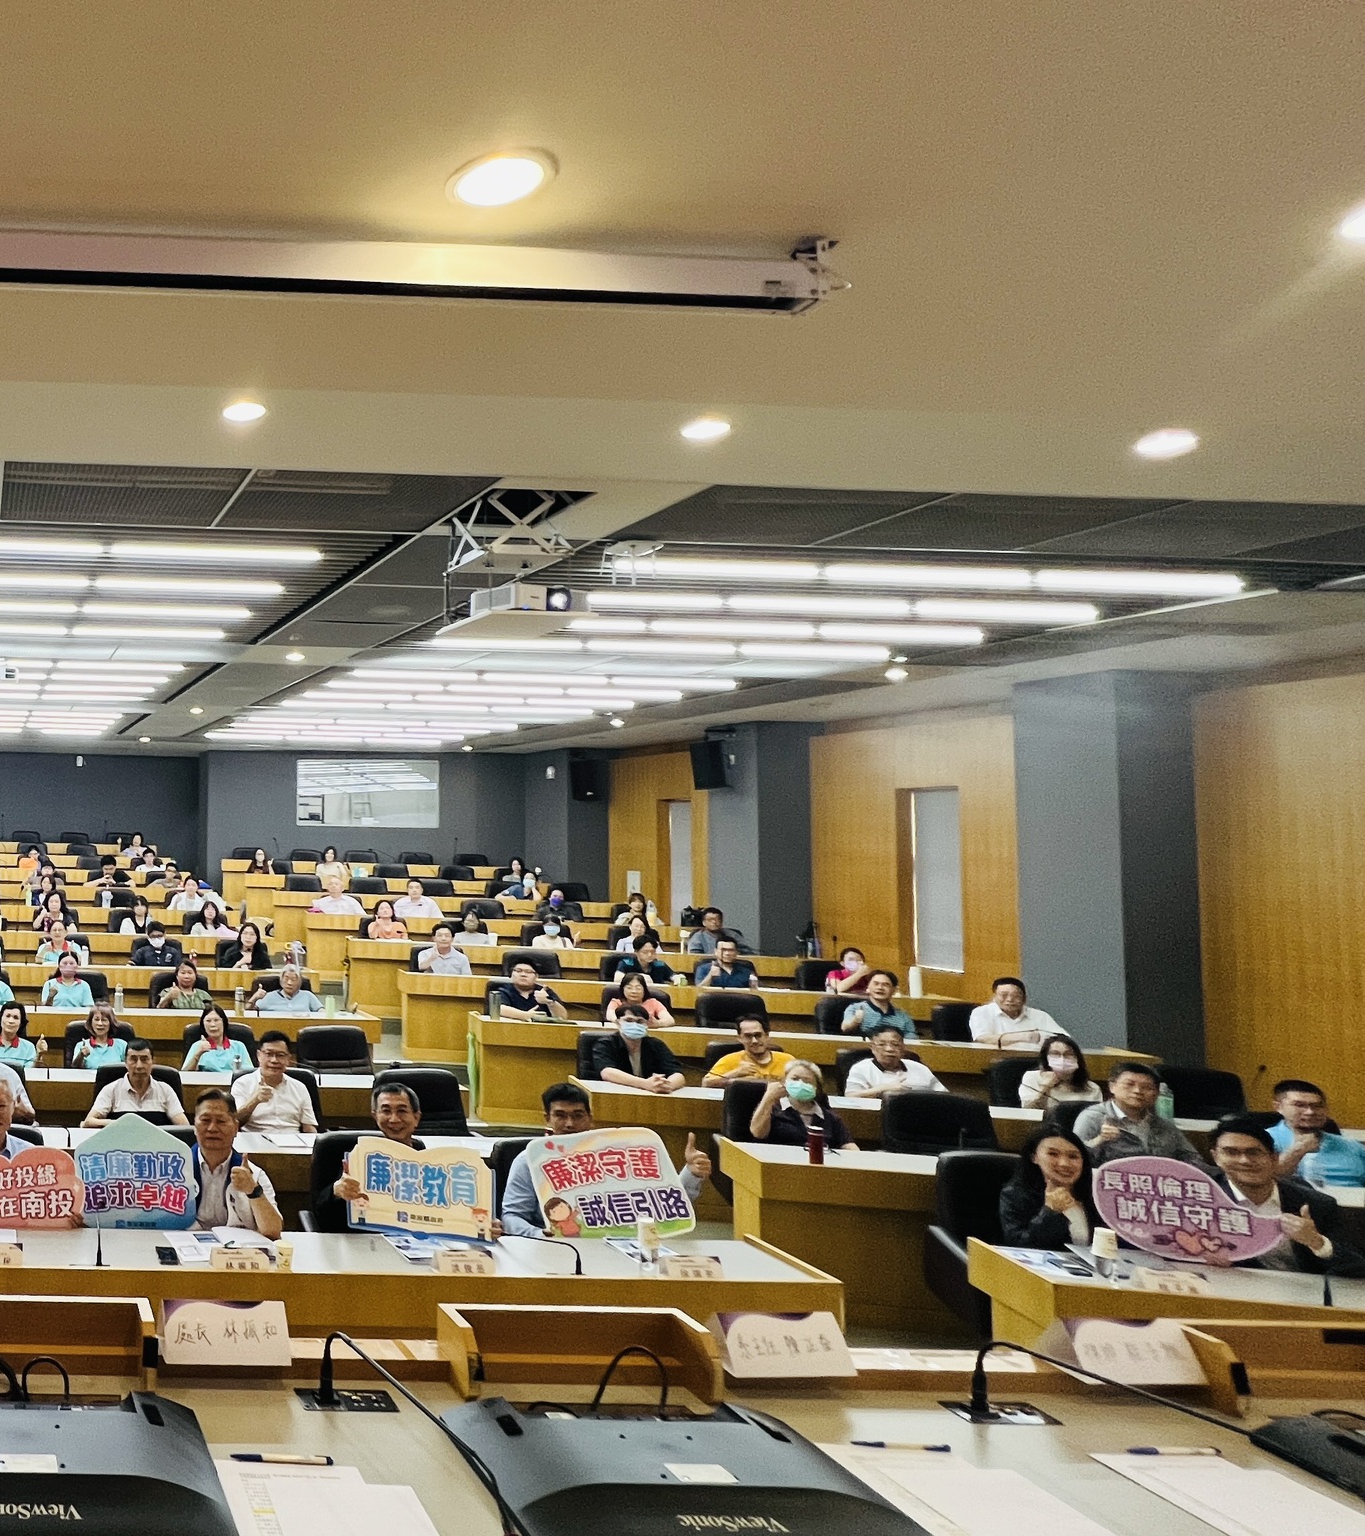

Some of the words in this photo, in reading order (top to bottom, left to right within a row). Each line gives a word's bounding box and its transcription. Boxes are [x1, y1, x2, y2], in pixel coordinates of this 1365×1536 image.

[80, 1151, 185, 1182] 清廉勤政
[366, 1152, 477, 1208] 廉潔教育
[542, 1147, 661, 1191] 廉潔守護
[84, 1182, 188, 1214] 追求卓越
[1101, 1171, 1213, 1202] 長照倫理
[577, 1186, 690, 1228] 誠信引路
[1116, 1196, 1252, 1236] 誠信守護
[676, 1514, 790, 1533] ViewSonic
